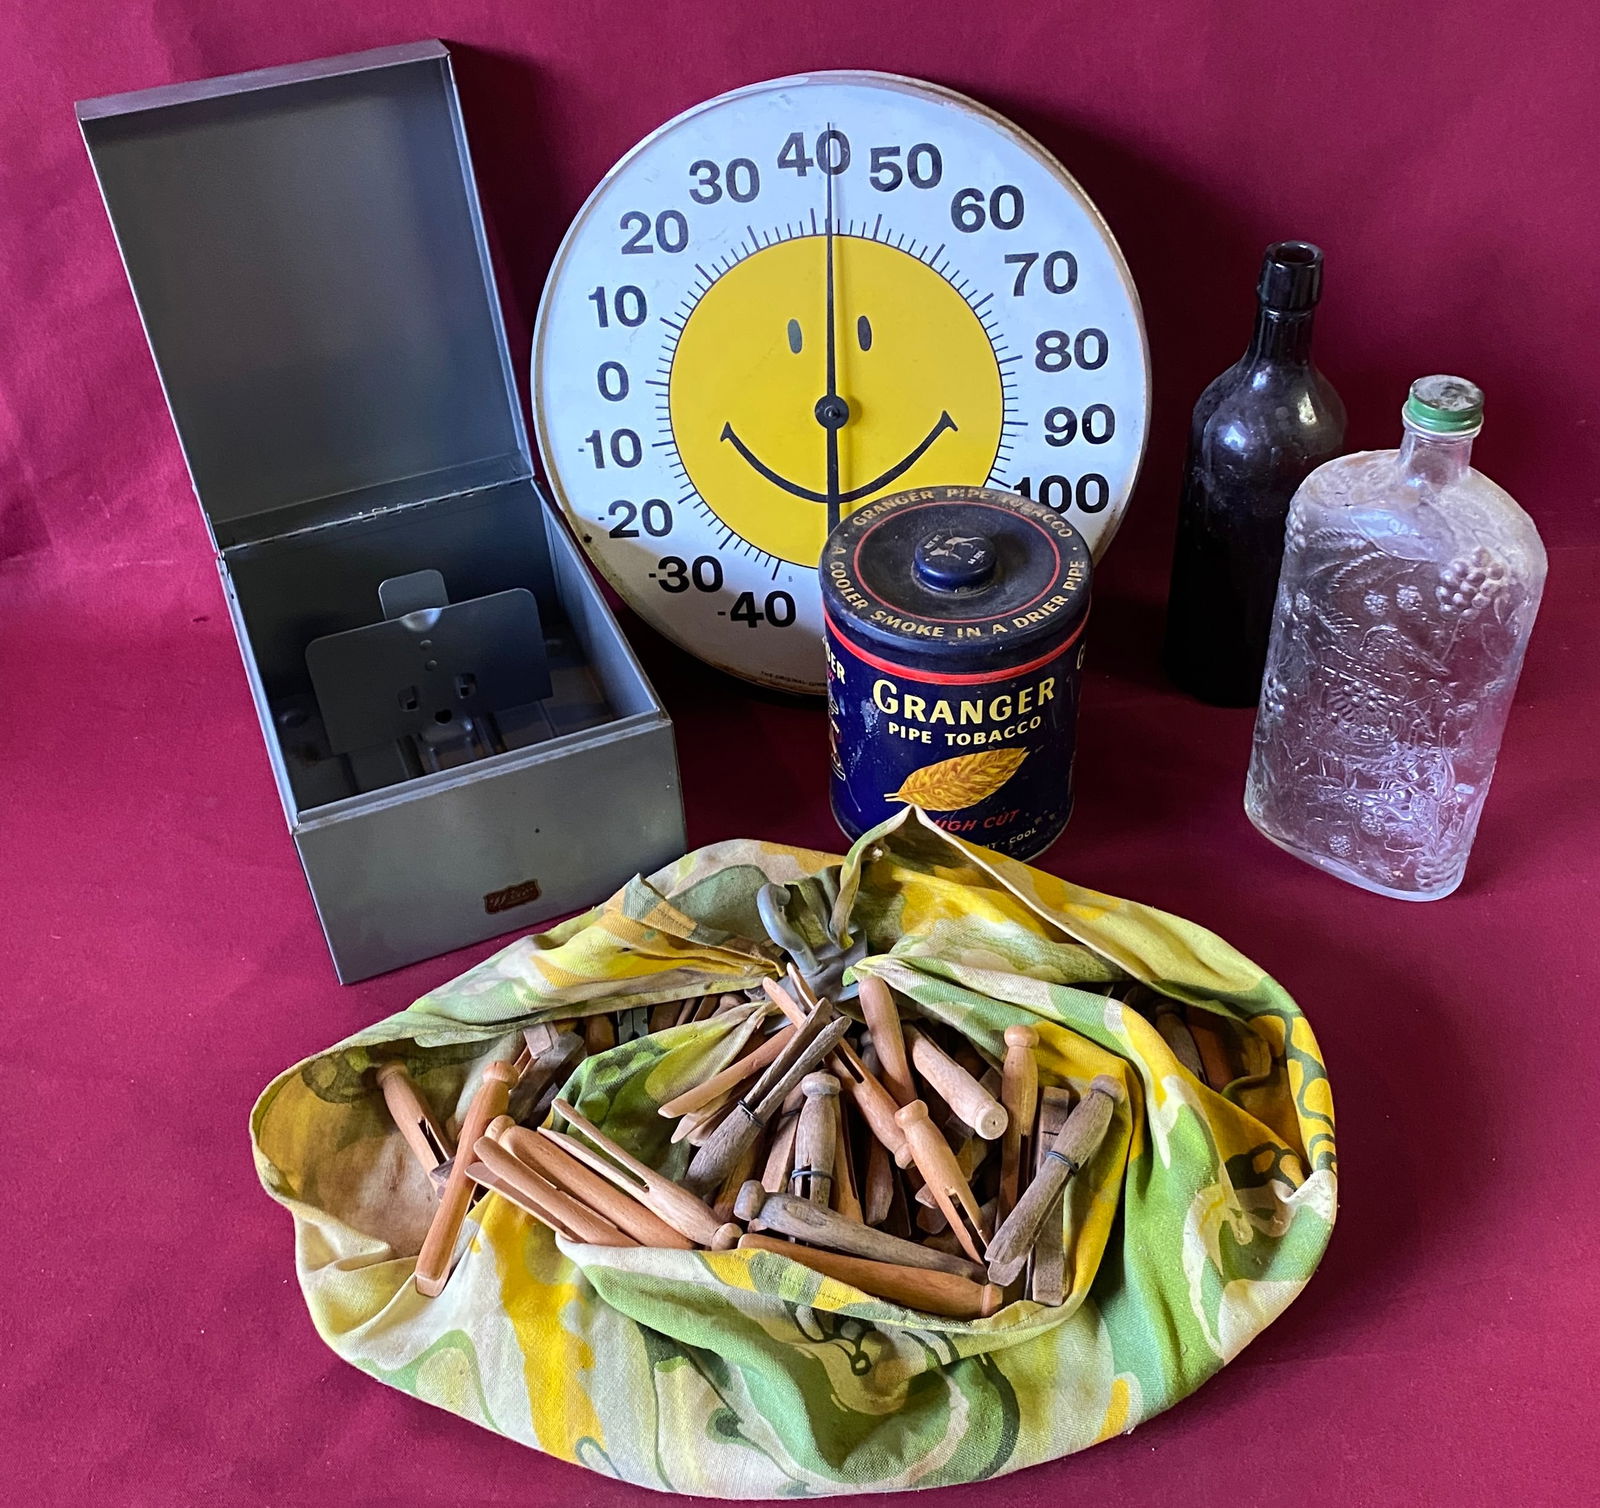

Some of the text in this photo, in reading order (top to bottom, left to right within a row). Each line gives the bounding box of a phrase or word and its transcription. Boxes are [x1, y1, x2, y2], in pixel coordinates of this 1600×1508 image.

[776, 129, 851, 177] 40
[869, 142, 943, 192] 50
[688, 157, 761, 205] 30
[950, 184, 1025, 233] 60
[619, 209, 690, 255] 20
[1003, 250, 1079, 297] 70
[588, 284, 648, 328] 10
[1034, 327, 1109, 373] 80
[596, 360, 630, 402] 0
[1043, 403, 1116, 448] 90
[577, 428, 643, 469] -10
[852, 487, 1074, 539] GRANGER PIPE TOBACCO
[1013, 472, 1110, 515] 100
[597, 498, 674, 539] -20
[648, 555, 724, 594] -30
[828, 545, 1086, 639] A COOLER SMOKE IN A DRIER PIPE
[716, 590, 797, 628] -40
[872, 676, 1056, 726] GRANGER
[887, 714, 1042, 747] PIPE TOBACCO
[983, 808, 1021, 829] CUT
[1008, 826, 1037, 845] COOL
